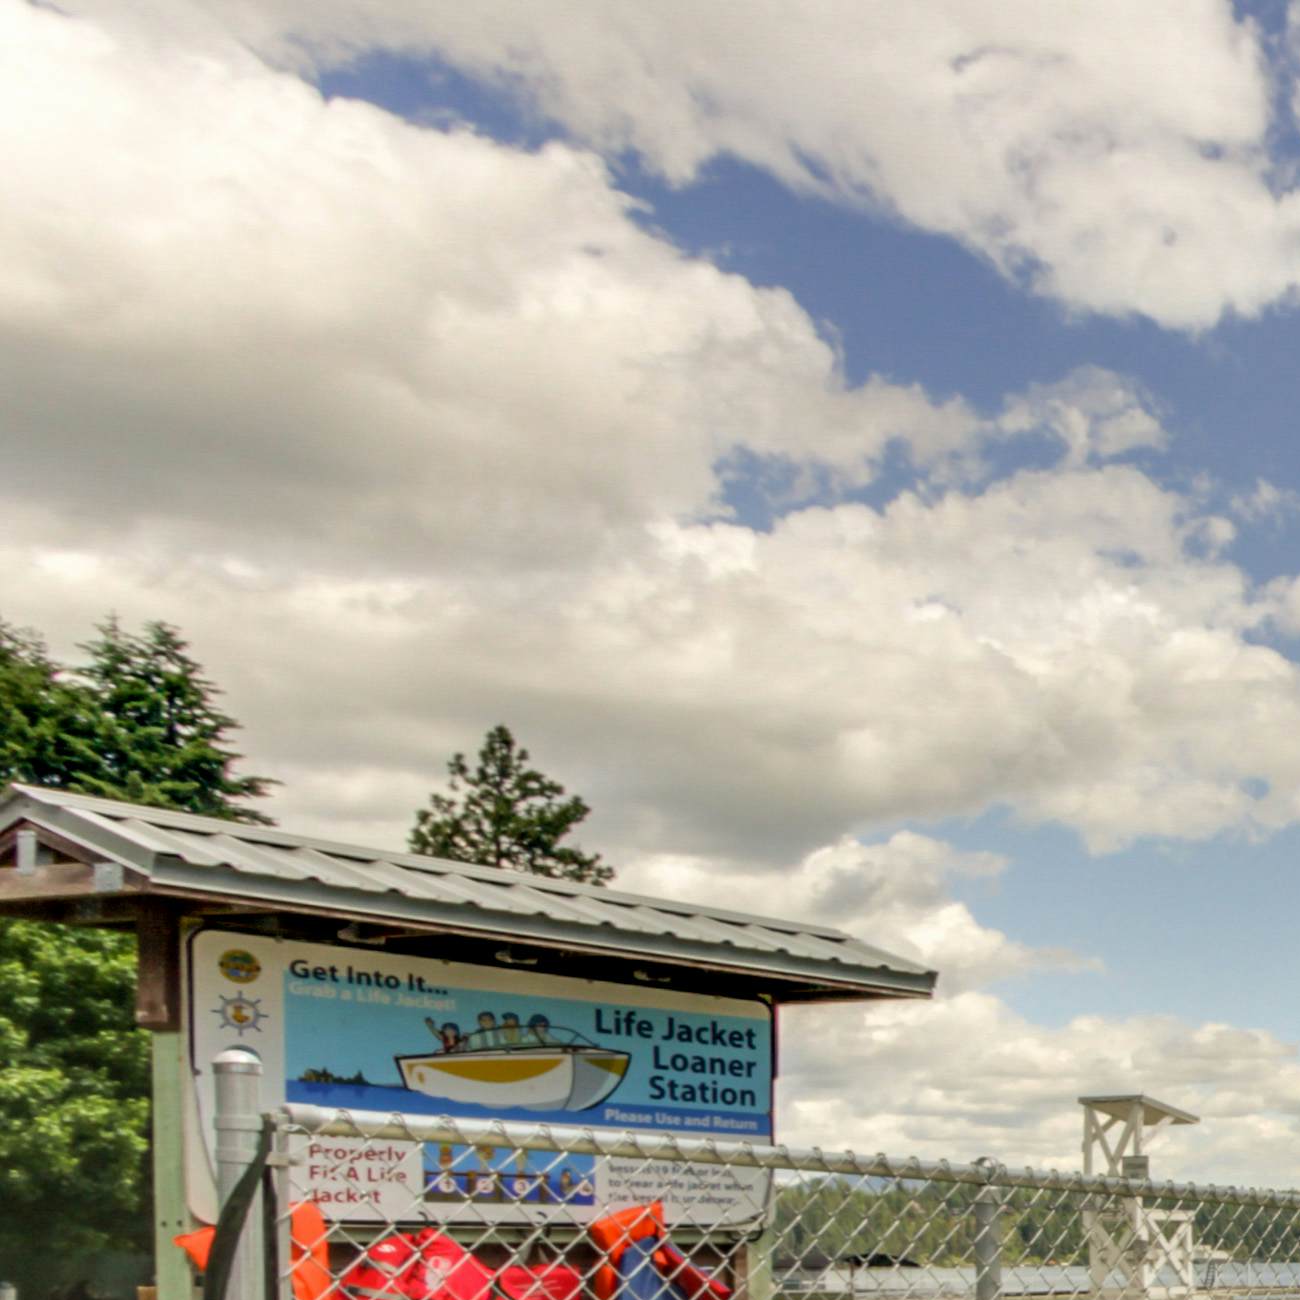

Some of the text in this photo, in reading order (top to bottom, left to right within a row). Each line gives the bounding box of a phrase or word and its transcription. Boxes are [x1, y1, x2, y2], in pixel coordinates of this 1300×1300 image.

[289, 959, 448, 995] Get Into It...
[595, 1008, 757, 1050] Life Jacket
[653, 1045, 757, 1078] Loaner
[649, 1075, 756, 1107] Station
[605, 1109, 758, 1130] Please Use and Return
[346, 1167, 359, 1181] A
